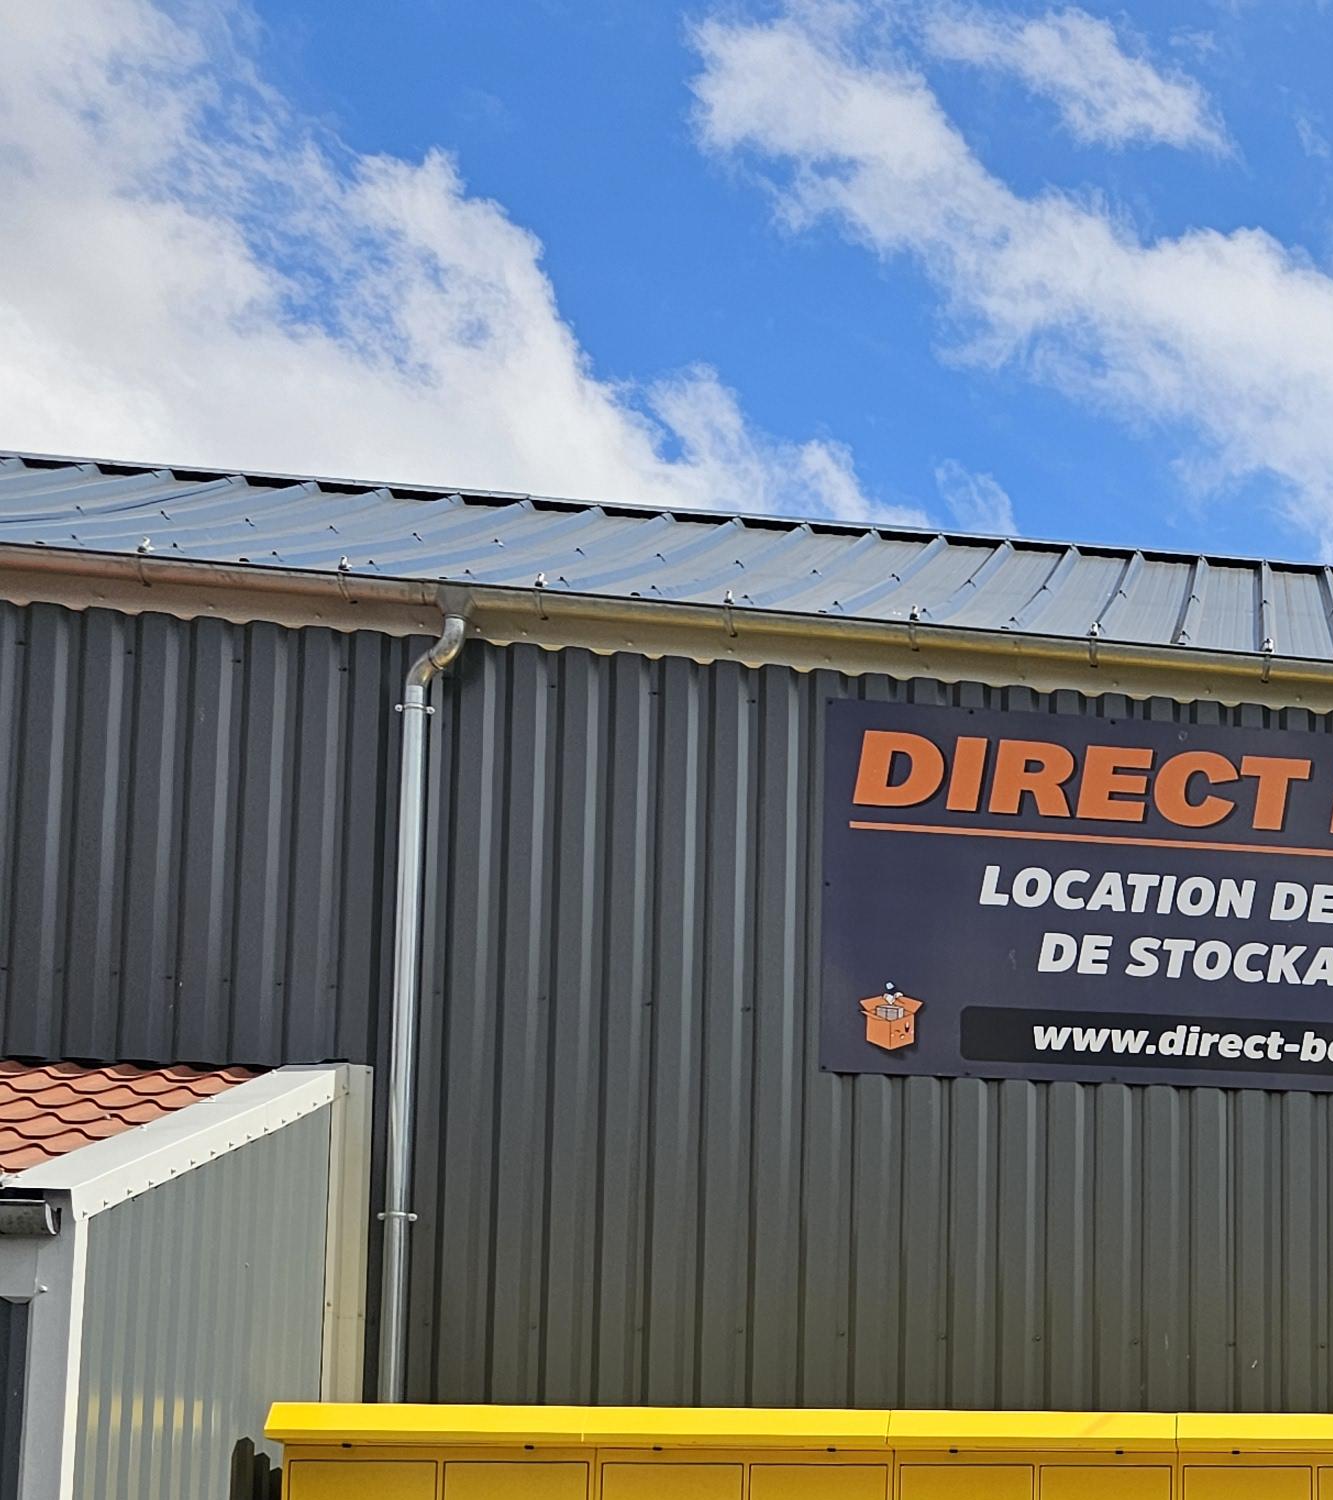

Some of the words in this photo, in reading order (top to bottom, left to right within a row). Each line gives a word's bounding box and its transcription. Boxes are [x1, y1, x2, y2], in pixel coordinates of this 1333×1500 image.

[853, 730, 1311, 831] DIRECT
[979, 865, 1257, 919] LOCATION
[1037, 932, 1114, 974] DE
